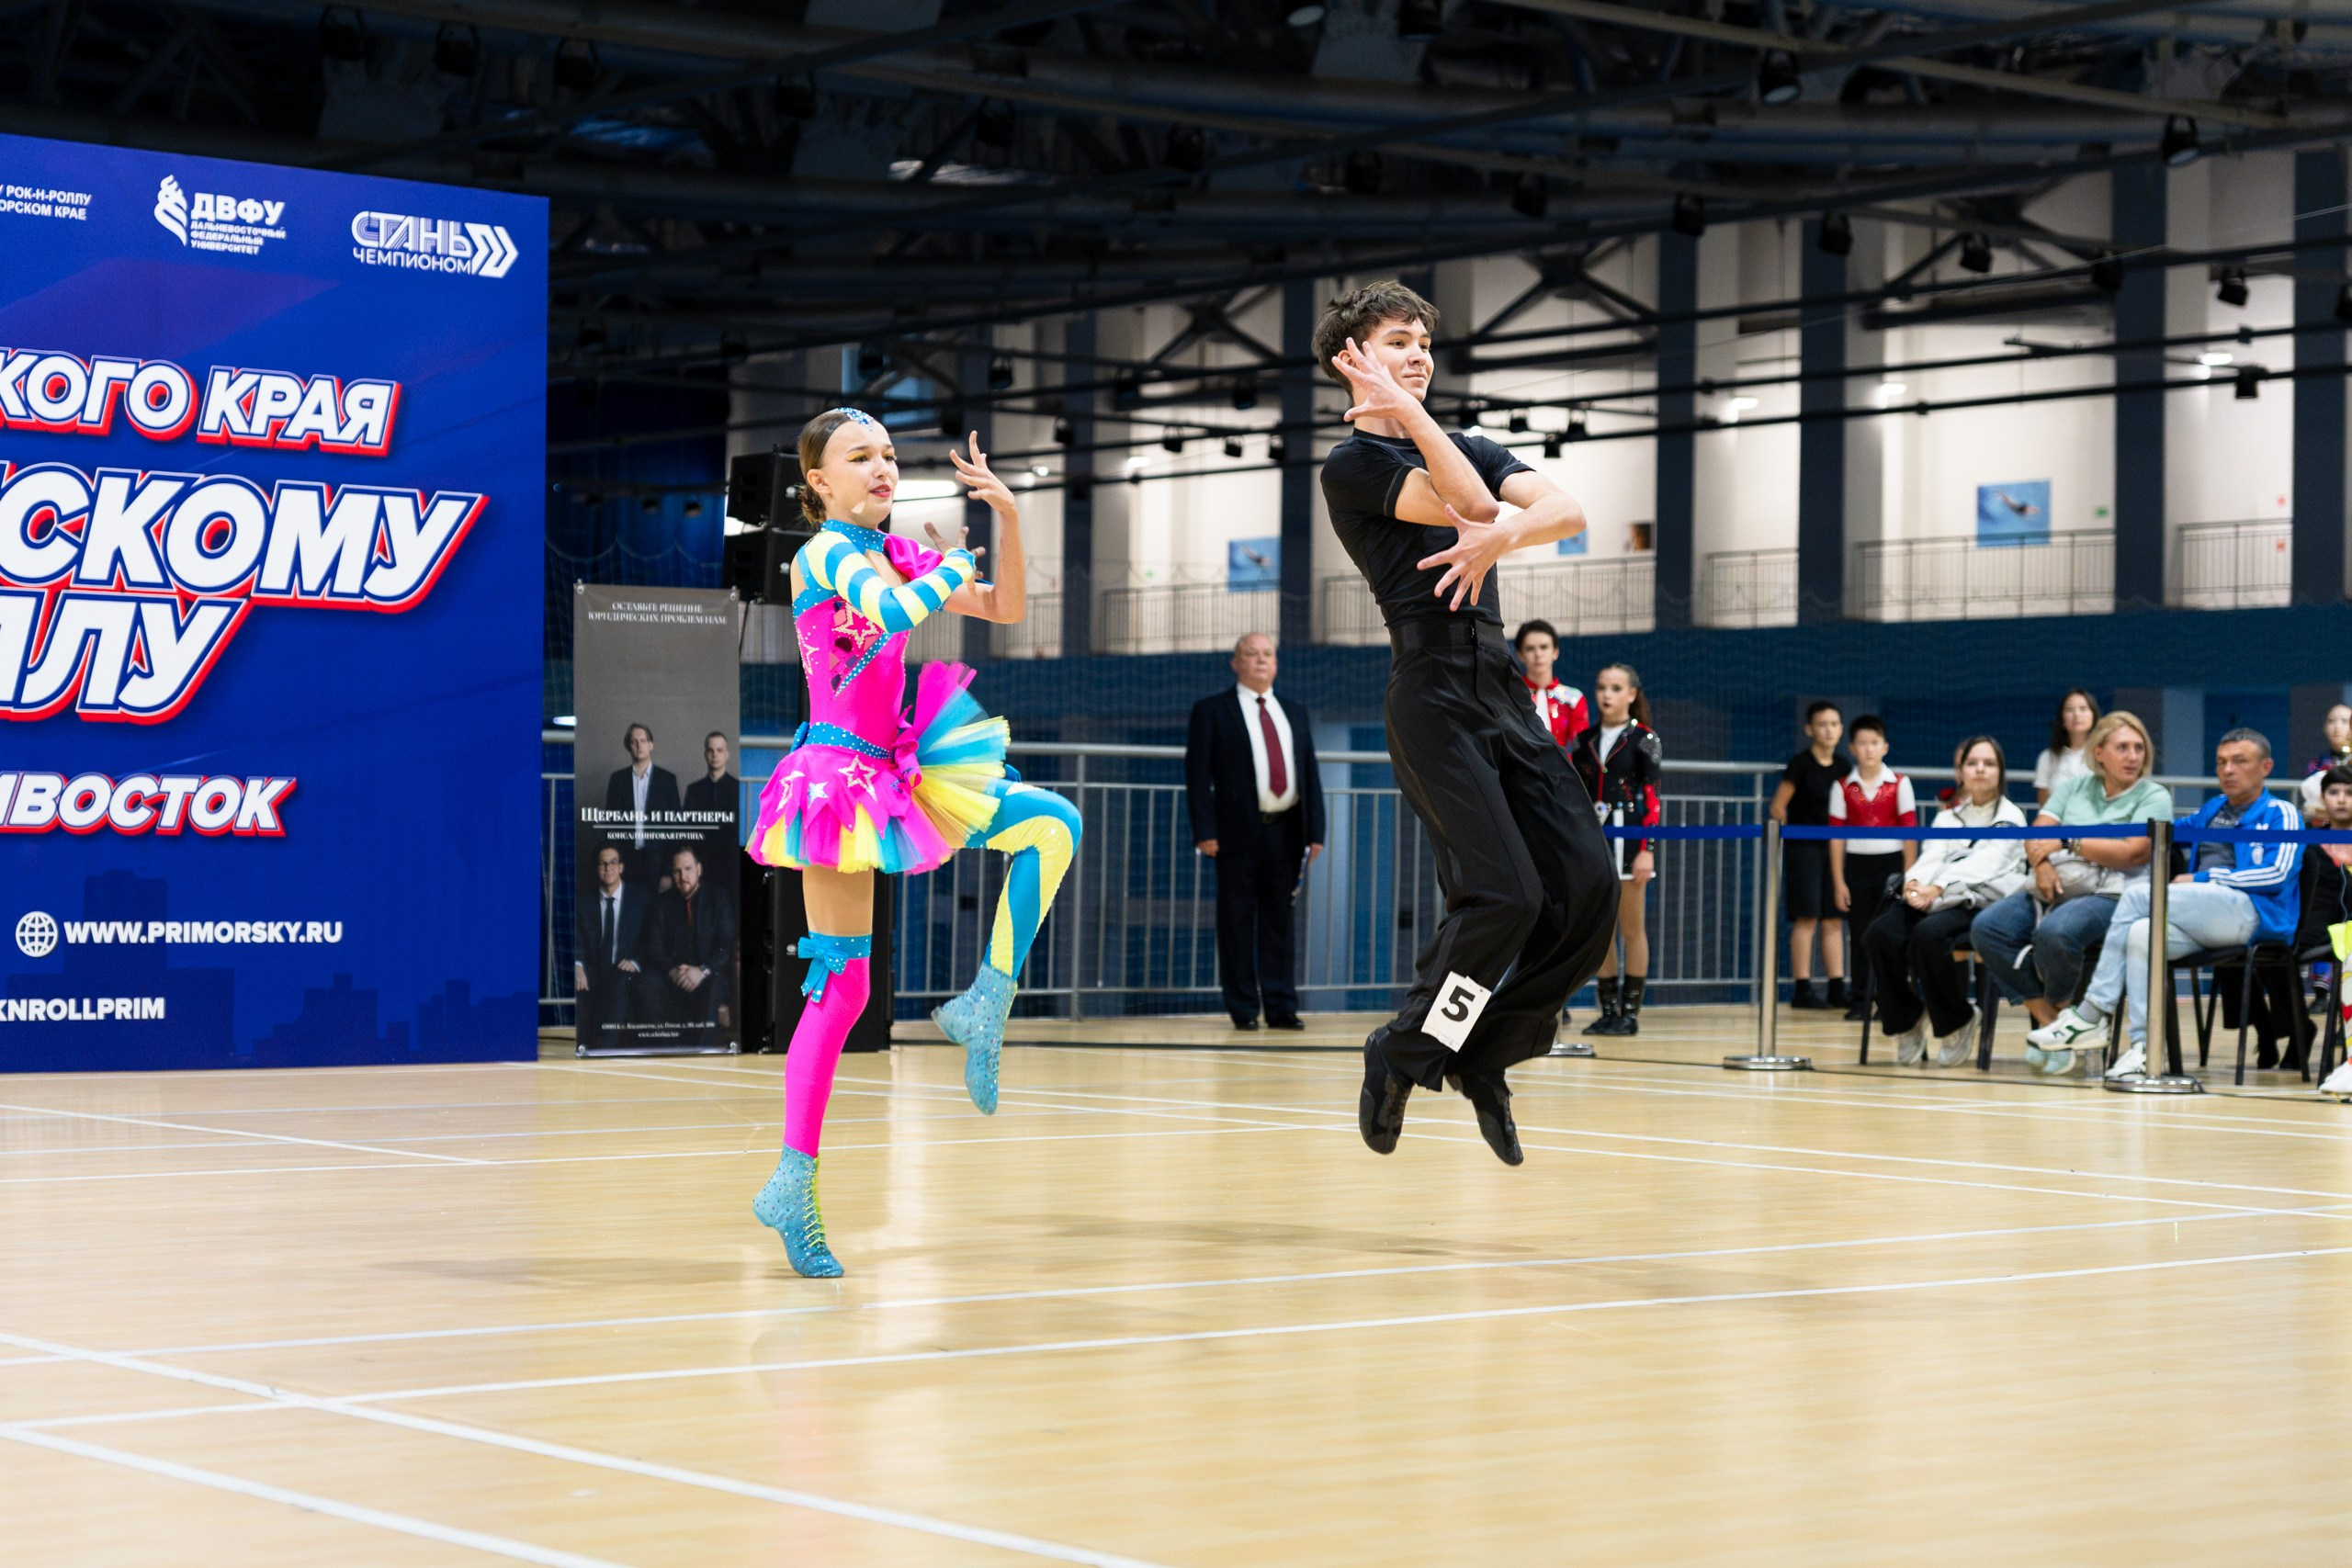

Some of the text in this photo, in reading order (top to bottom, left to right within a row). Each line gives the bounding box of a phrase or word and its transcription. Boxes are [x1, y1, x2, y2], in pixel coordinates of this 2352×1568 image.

[6, 185, 91, 206] РОК-Н-РОЛЛУ
[55, 205, 87, 221] КРАЕ
[190, 192, 285, 226] ДВФУ
[190, 220, 287, 240] ДАЛЬНЕВОСТОЧНЫЙ
[190, 230, 264, 246] ФЕДЕРАЛЬНЫЙ
[351, 210, 473, 258] СТАНЬ
[190, 239, 260, 255] УНИВЕРСИТЕТ
[353, 247, 472, 275] ЧЕМПИОНОМ
[197, 366, 401, 456] КРАЯ
[650, 811, 662, 822] И
[63, 920, 343, 944] WWW.PRIMORSKY.RU
[1441, 985, 1476, 1022] 5
